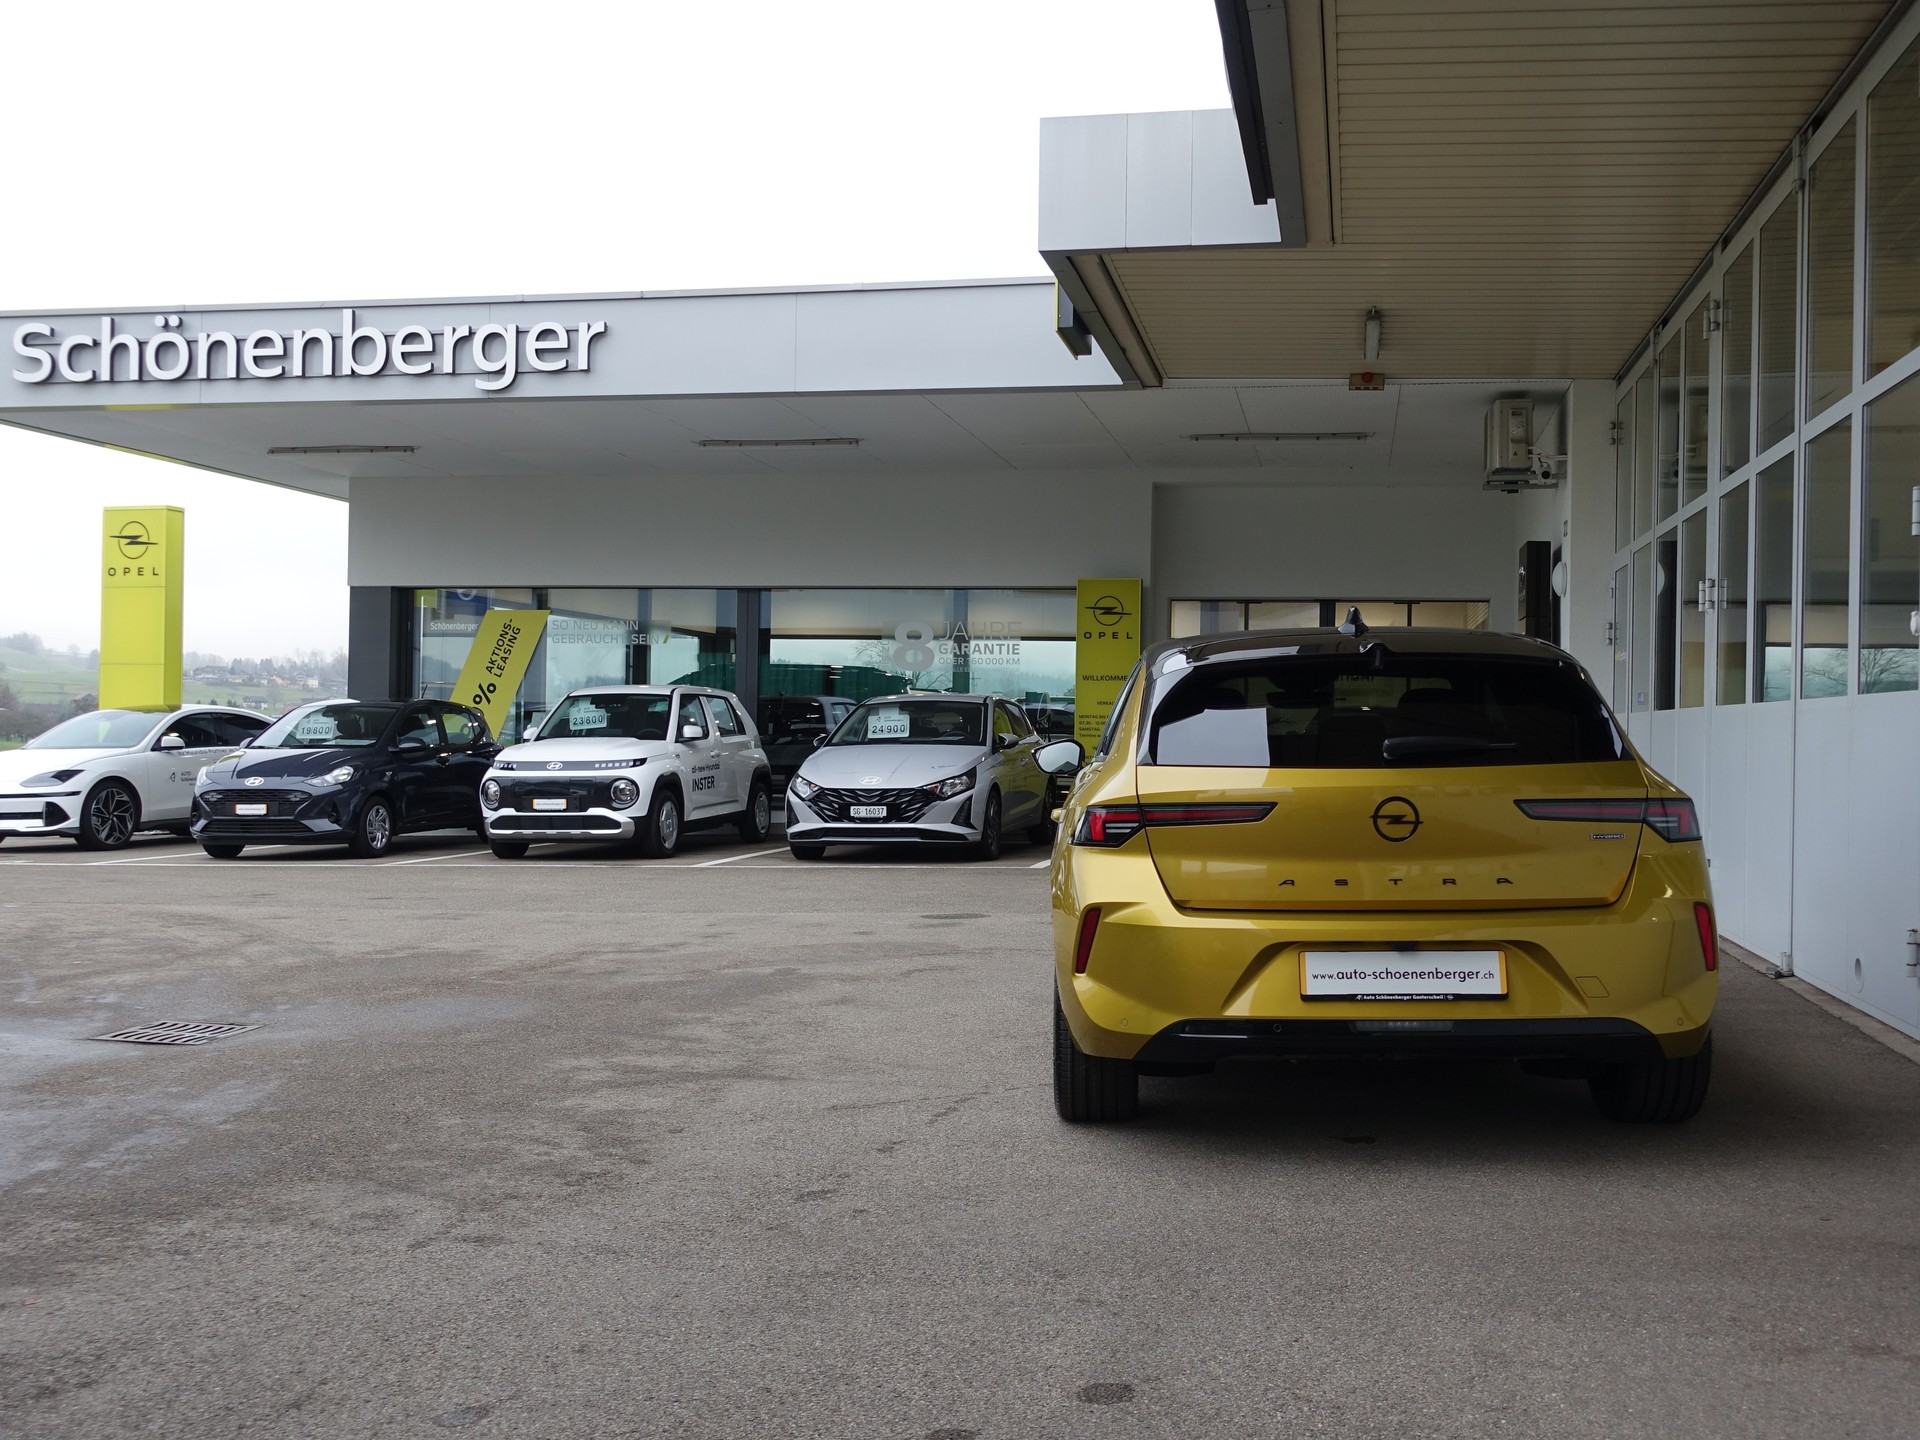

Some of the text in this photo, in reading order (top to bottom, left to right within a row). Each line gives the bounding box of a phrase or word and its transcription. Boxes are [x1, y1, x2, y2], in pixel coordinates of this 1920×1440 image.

[12, 308, 607, 391] Schönenberger
[107, 567, 160, 577] OPEL
[430, 621, 479, 634] Schönenberger
[552, 620, 639, 630] SO NEU KANN
[939, 621, 1021, 640] JAHRE
[631, 633, 659, 644] SEIN
[1084, 631, 1133, 640] OPEL
[486, 618, 513, 674] AKTIONS-
[494, 626, 521, 678] LEASING
[893, 621, 935, 671] 8
[938, 643, 1020, 655] GARANTIE
[938, 657, 964, 665] ODER
[1006, 657, 1020, 665] KM
[472, 682, 497, 706] %
[572, 714, 604, 726] 23800
[871, 724, 907, 734] 24900
[692, 776, 716, 792] INSTER
[852, 807, 884, 815] SG 16037
[1279, 878, 1514, 887] ASTRA
[1312, 967, 1495, 983] www.auto-schoenenberger.ch
